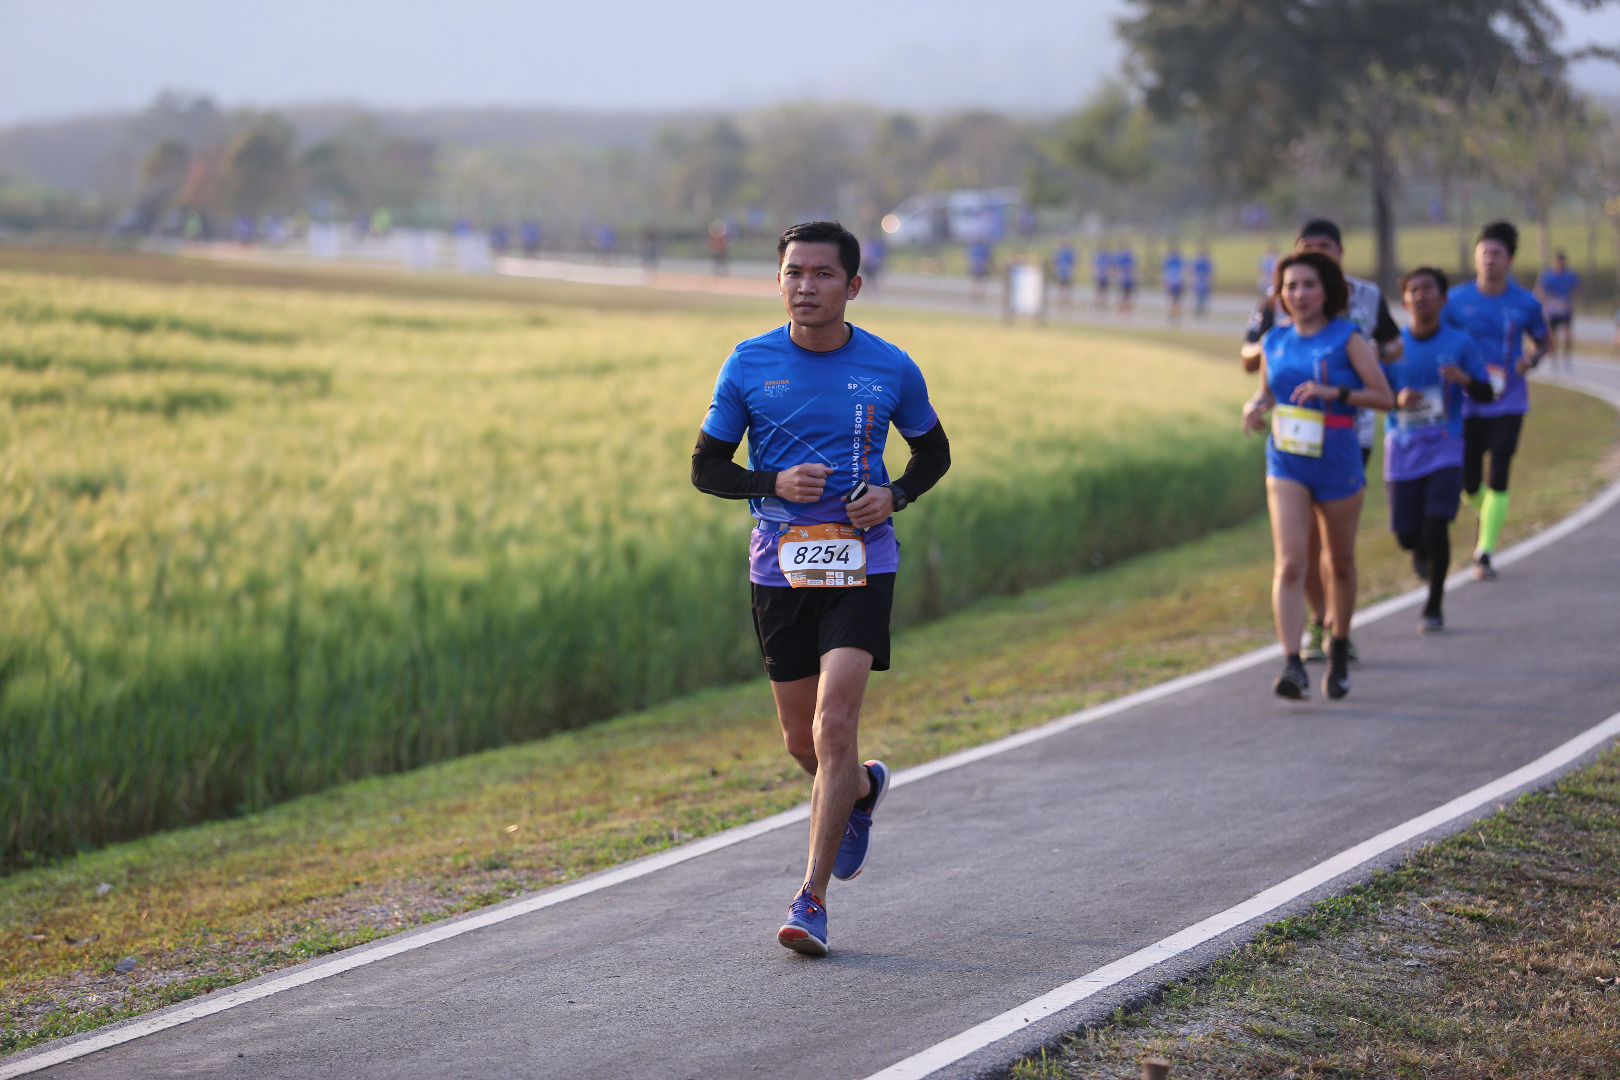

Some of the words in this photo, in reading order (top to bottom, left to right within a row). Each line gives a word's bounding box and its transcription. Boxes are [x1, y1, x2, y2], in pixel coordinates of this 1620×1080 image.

[864, 405, 875, 443] SINGHA
[852, 437, 860, 478] COUNTRY
[862, 446, 871, 470] PARK
[794, 544, 850, 564] 8254
